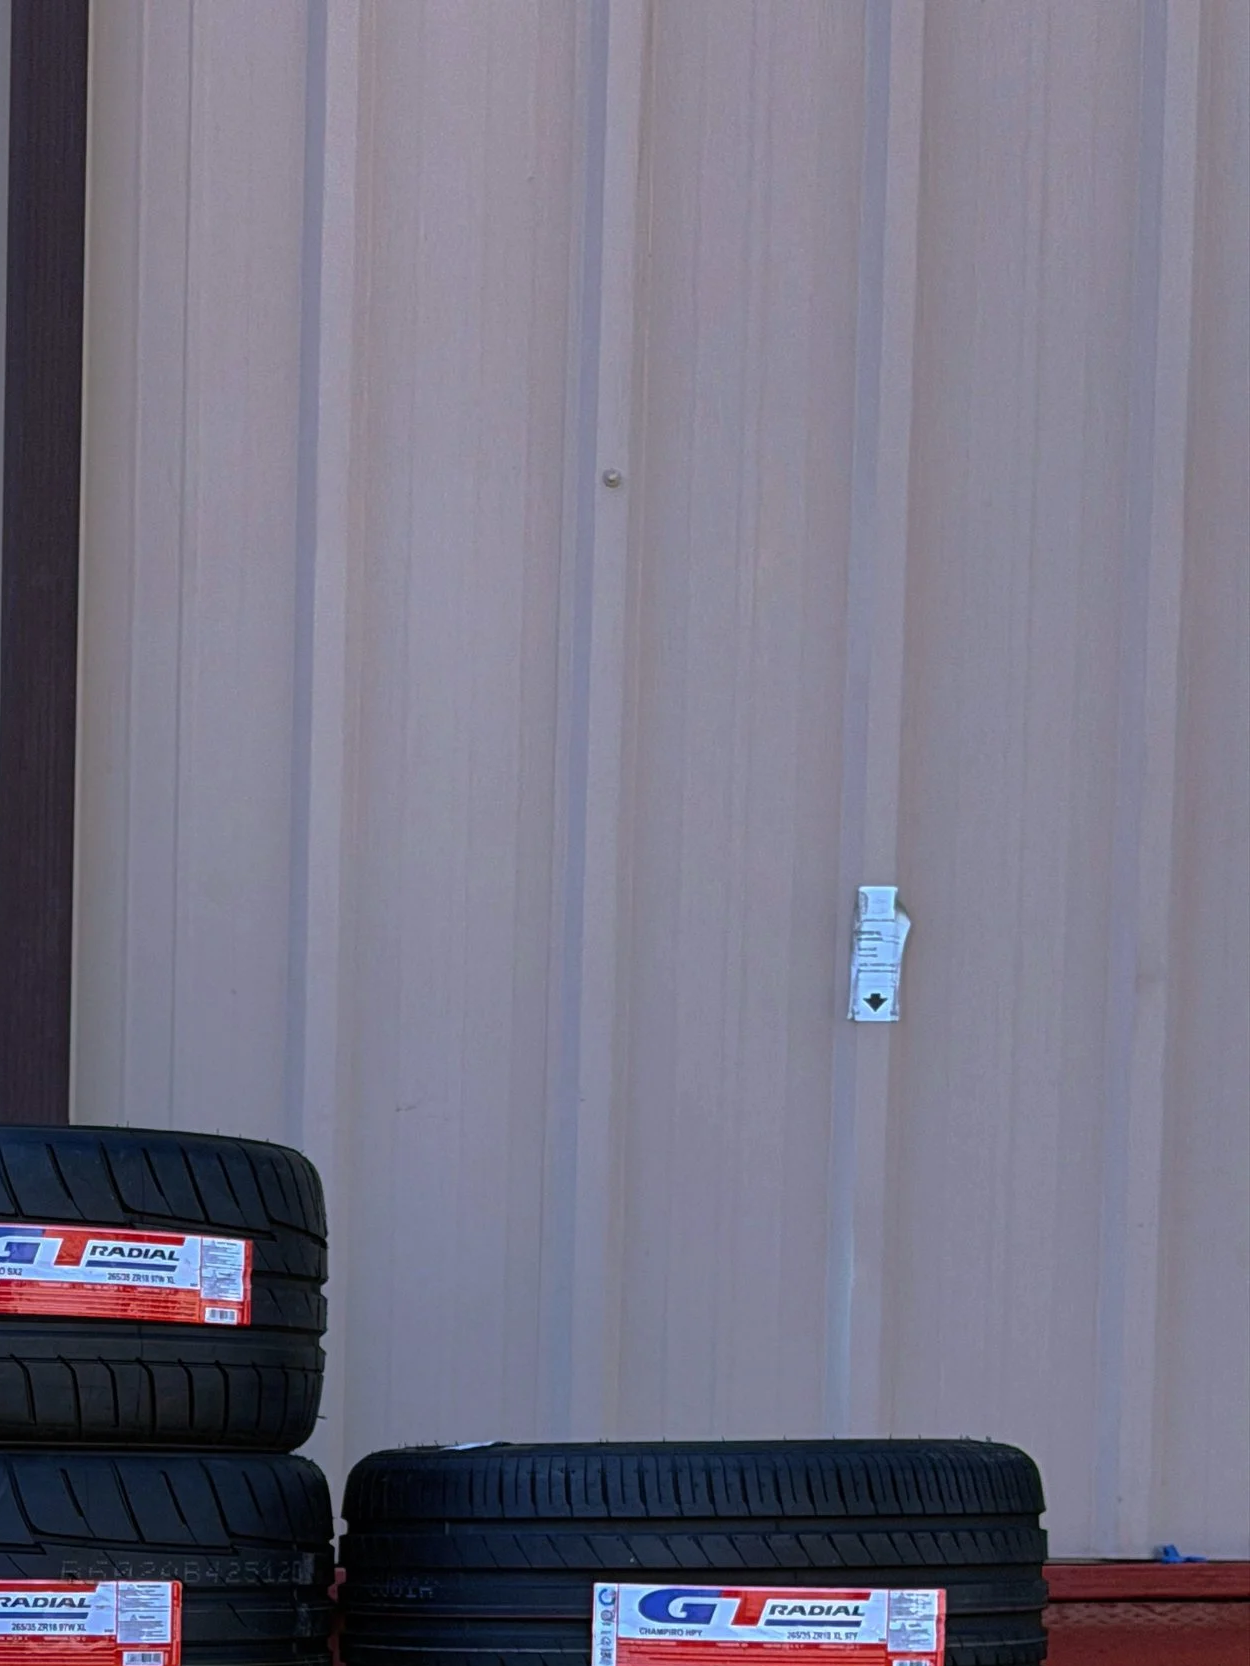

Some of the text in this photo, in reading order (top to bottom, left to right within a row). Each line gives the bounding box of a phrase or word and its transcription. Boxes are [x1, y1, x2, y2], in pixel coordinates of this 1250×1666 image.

[90, 1246, 180, 1262] RADIAL
[769, 1603, 865, 1618] RADIAL
[76, 1623, 87, 1632] XL
[639, 1627, 684, 1637] CHAMPIRO
